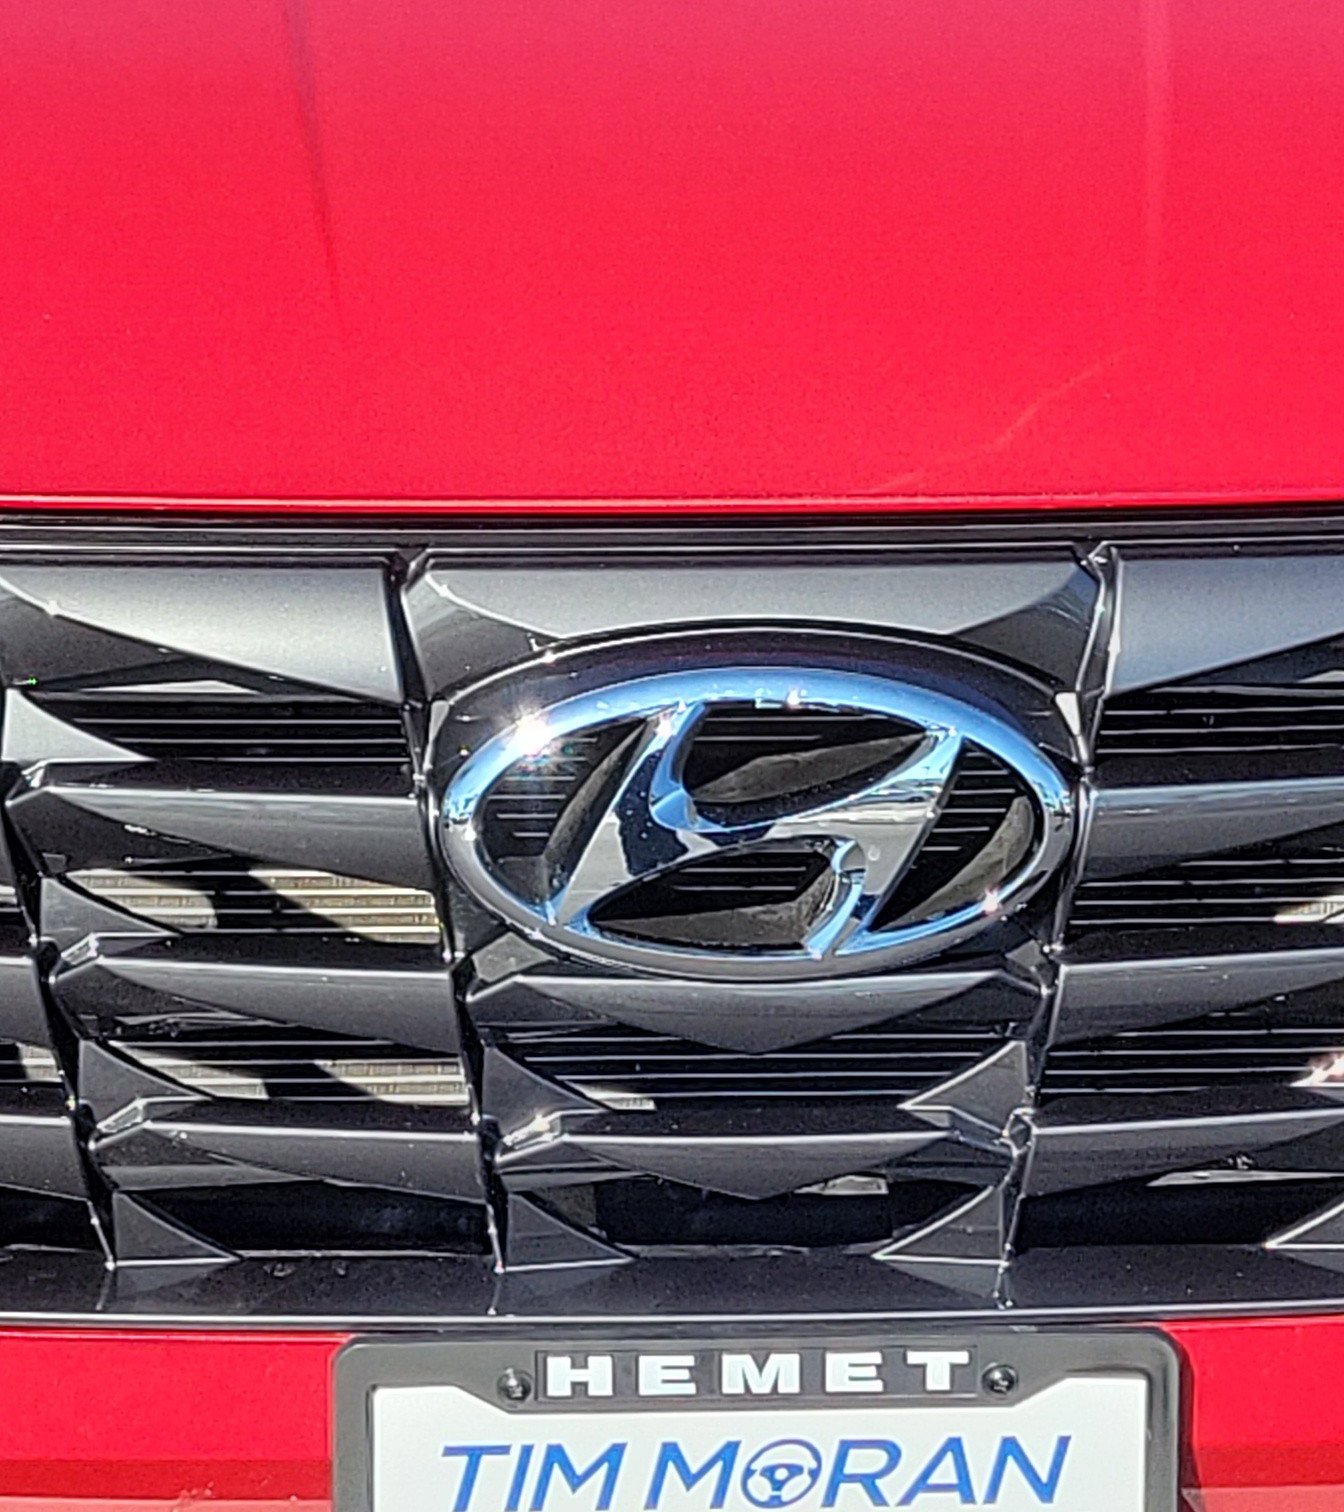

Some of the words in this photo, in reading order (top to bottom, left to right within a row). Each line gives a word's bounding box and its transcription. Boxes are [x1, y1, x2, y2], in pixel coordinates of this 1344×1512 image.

[545, 1349, 970, 1398] HEMET
[441, 1441, 628, 1512] TIM
[643, 1434, 1072, 1510] MORAN
